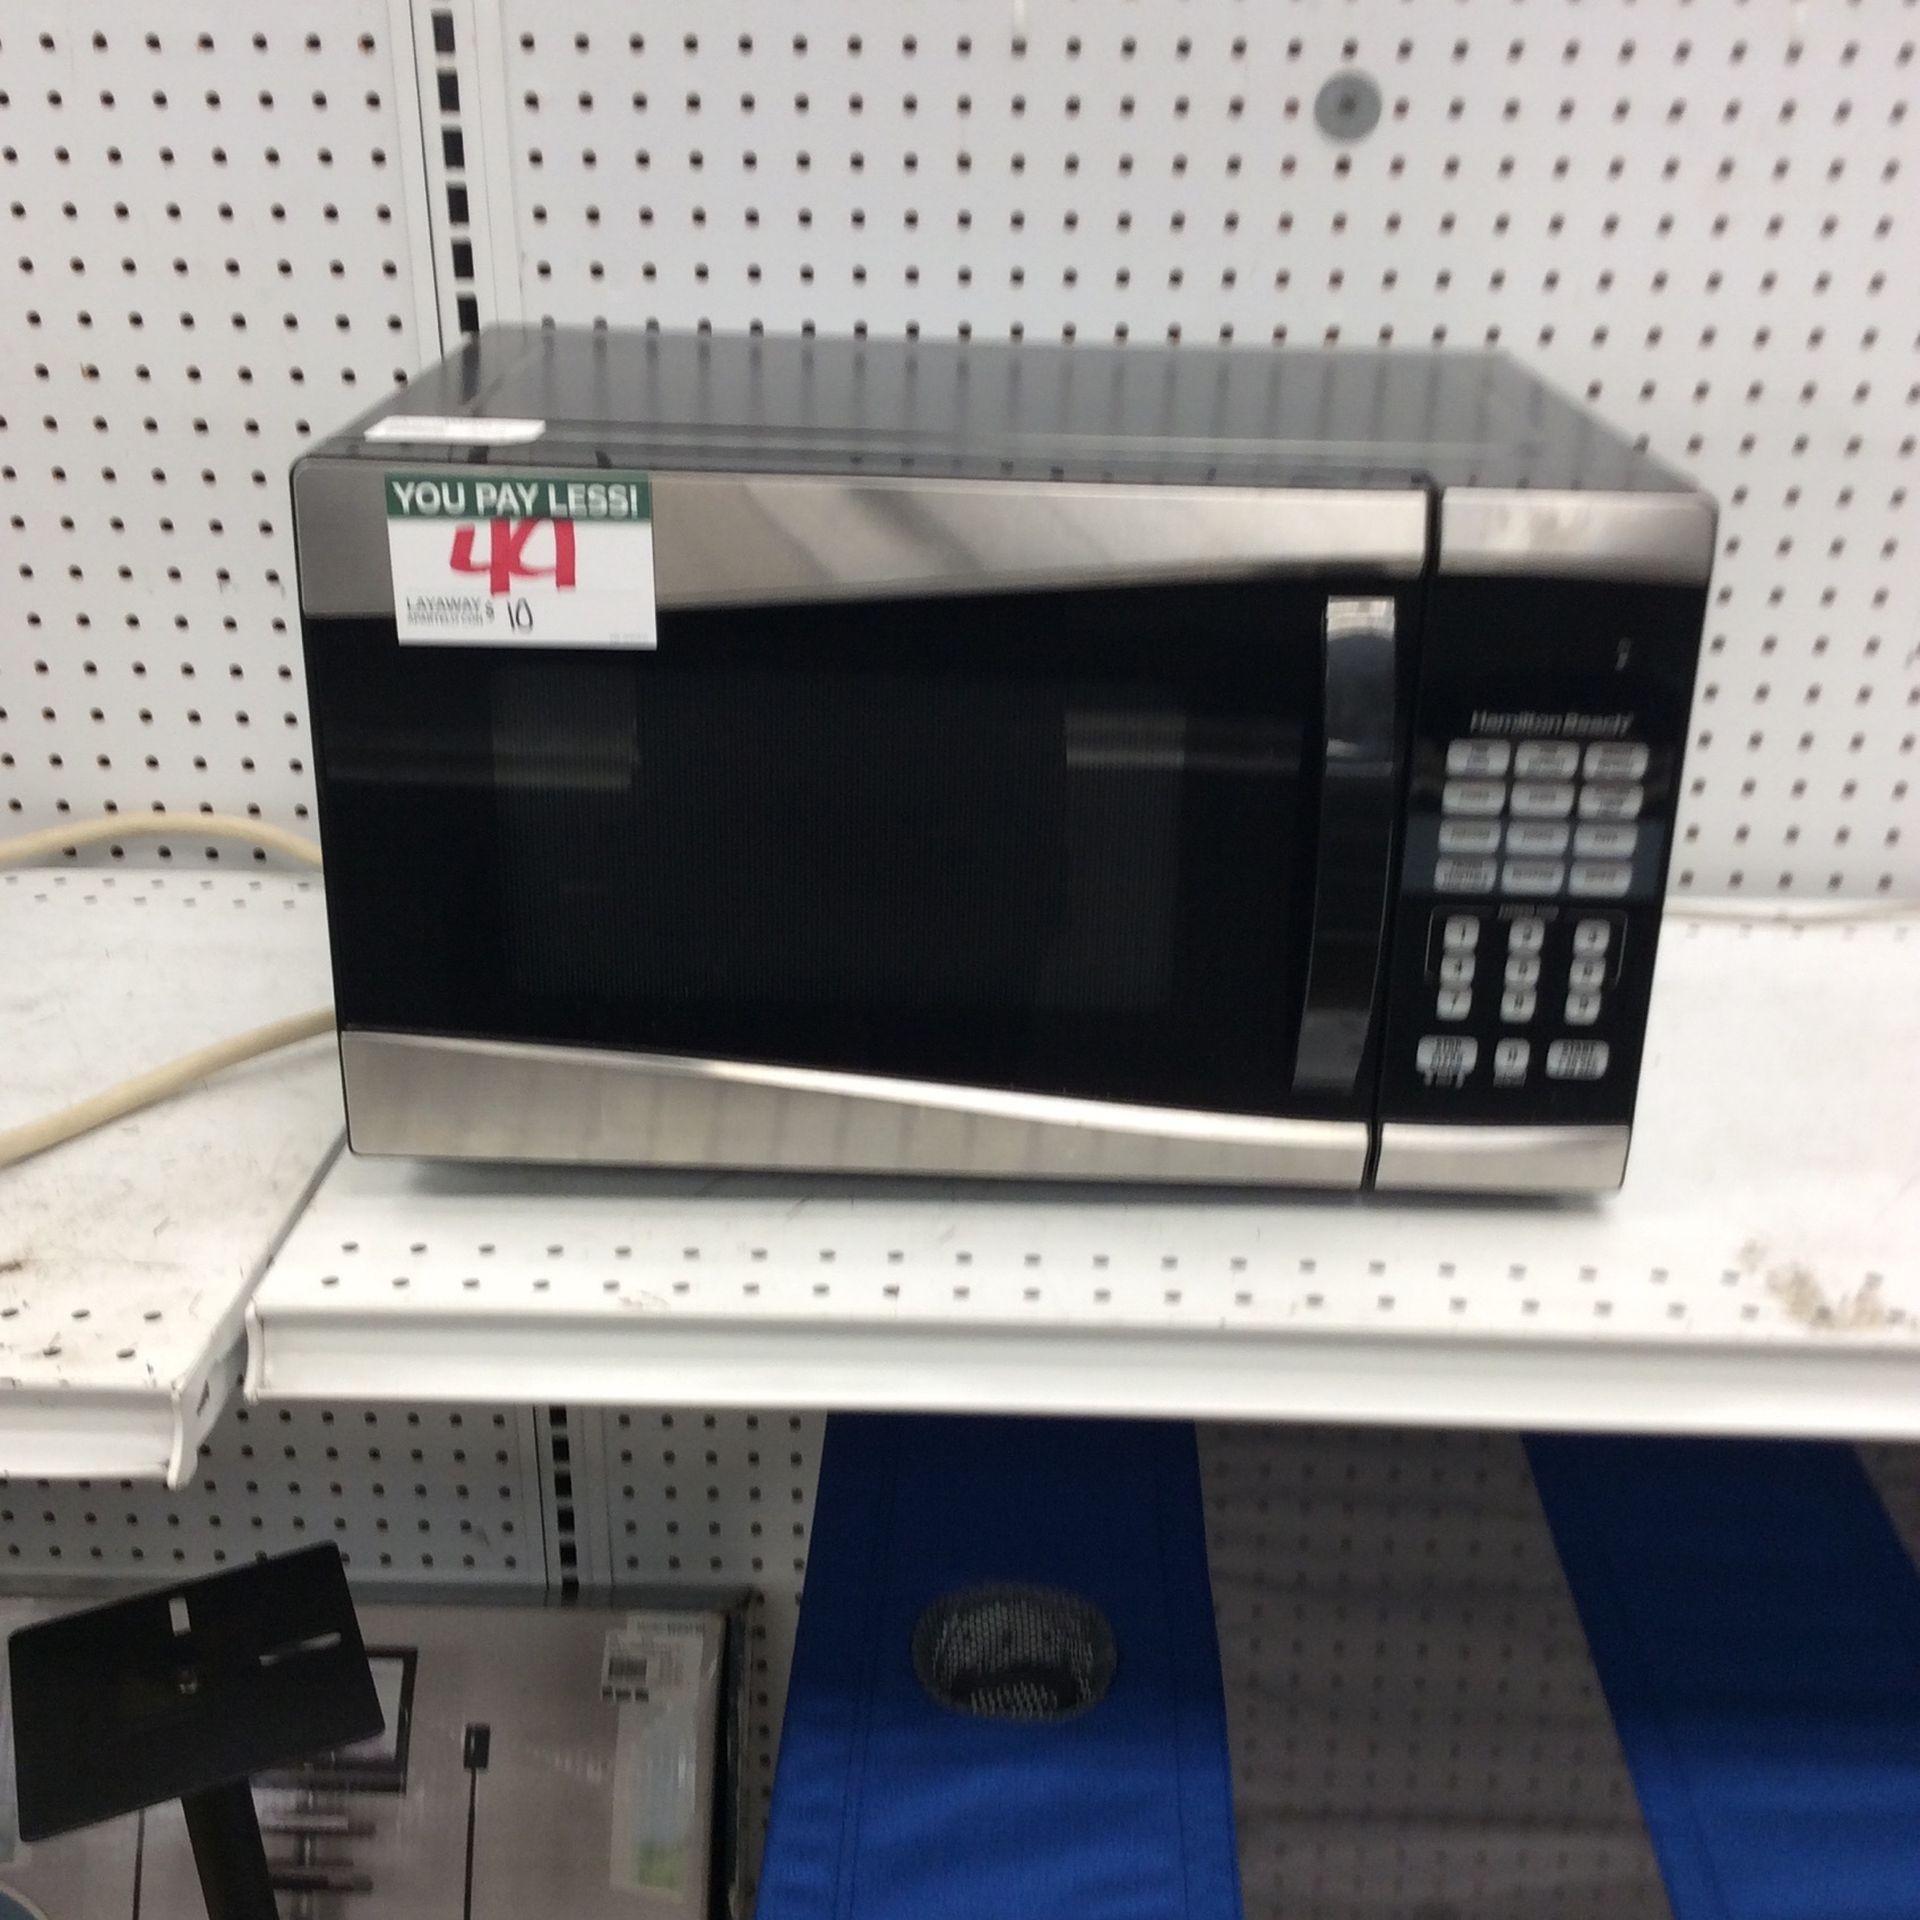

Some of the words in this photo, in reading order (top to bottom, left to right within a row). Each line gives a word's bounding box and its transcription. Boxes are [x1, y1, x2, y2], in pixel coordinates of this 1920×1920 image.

[391, 480, 466, 516] YOU
[475, 481, 540, 517] PAY
[547, 482, 639, 519] LESS!
[405, 596, 482, 612] LAYAWAY
[506, 597, 535, 633] 10
